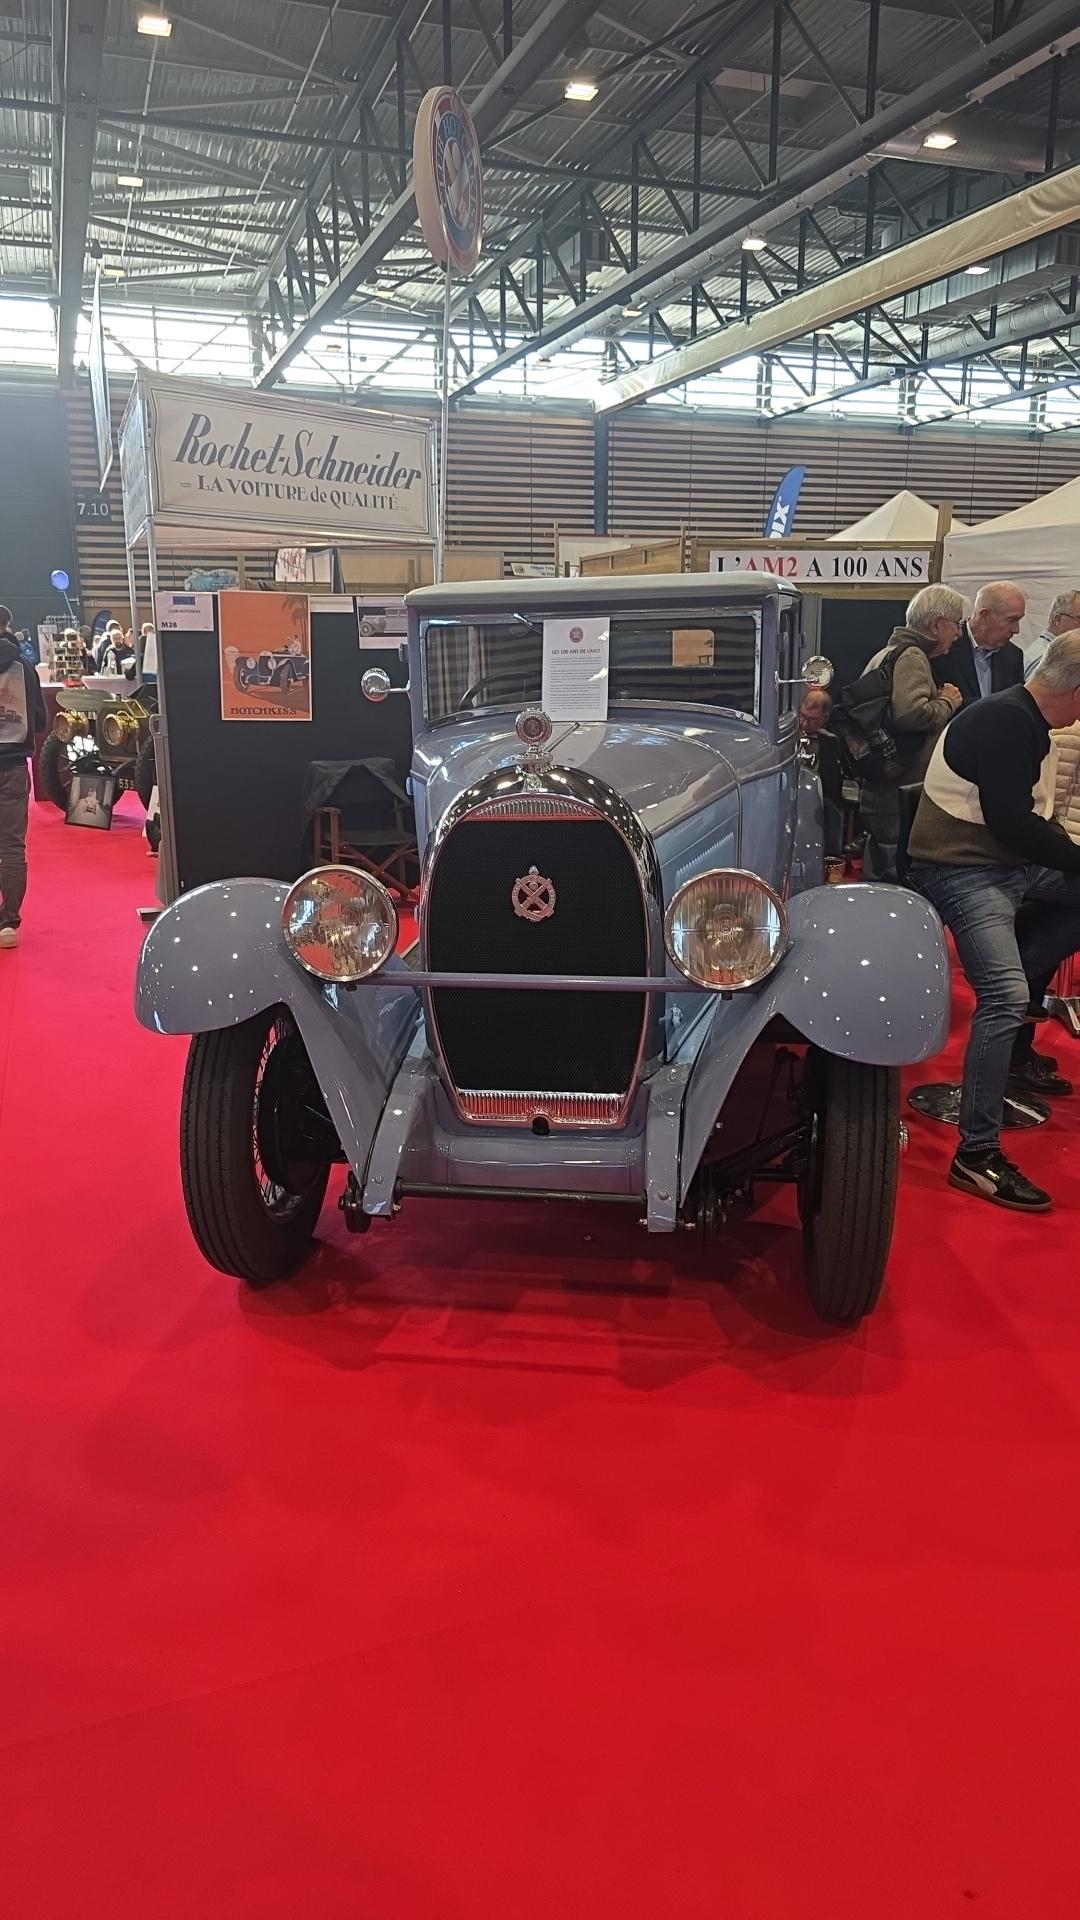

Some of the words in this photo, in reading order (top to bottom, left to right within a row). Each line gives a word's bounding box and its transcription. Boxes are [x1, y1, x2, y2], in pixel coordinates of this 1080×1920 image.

[174, 413, 422, 490] Rochet-Schneider
[196, 474, 224, 493] LA
[226, 478, 308, 501] VOITURE
[310, 486, 327, 503] de
[330, 490, 398, 511] QUALITÉ
[77, 502, 109, 516] 7.10
[806, 556, 823, 577] A
[832, 556, 868, 577] 100
[875, 556, 923, 577] ANS
[230, 707, 297, 715] HOTCHKISS
